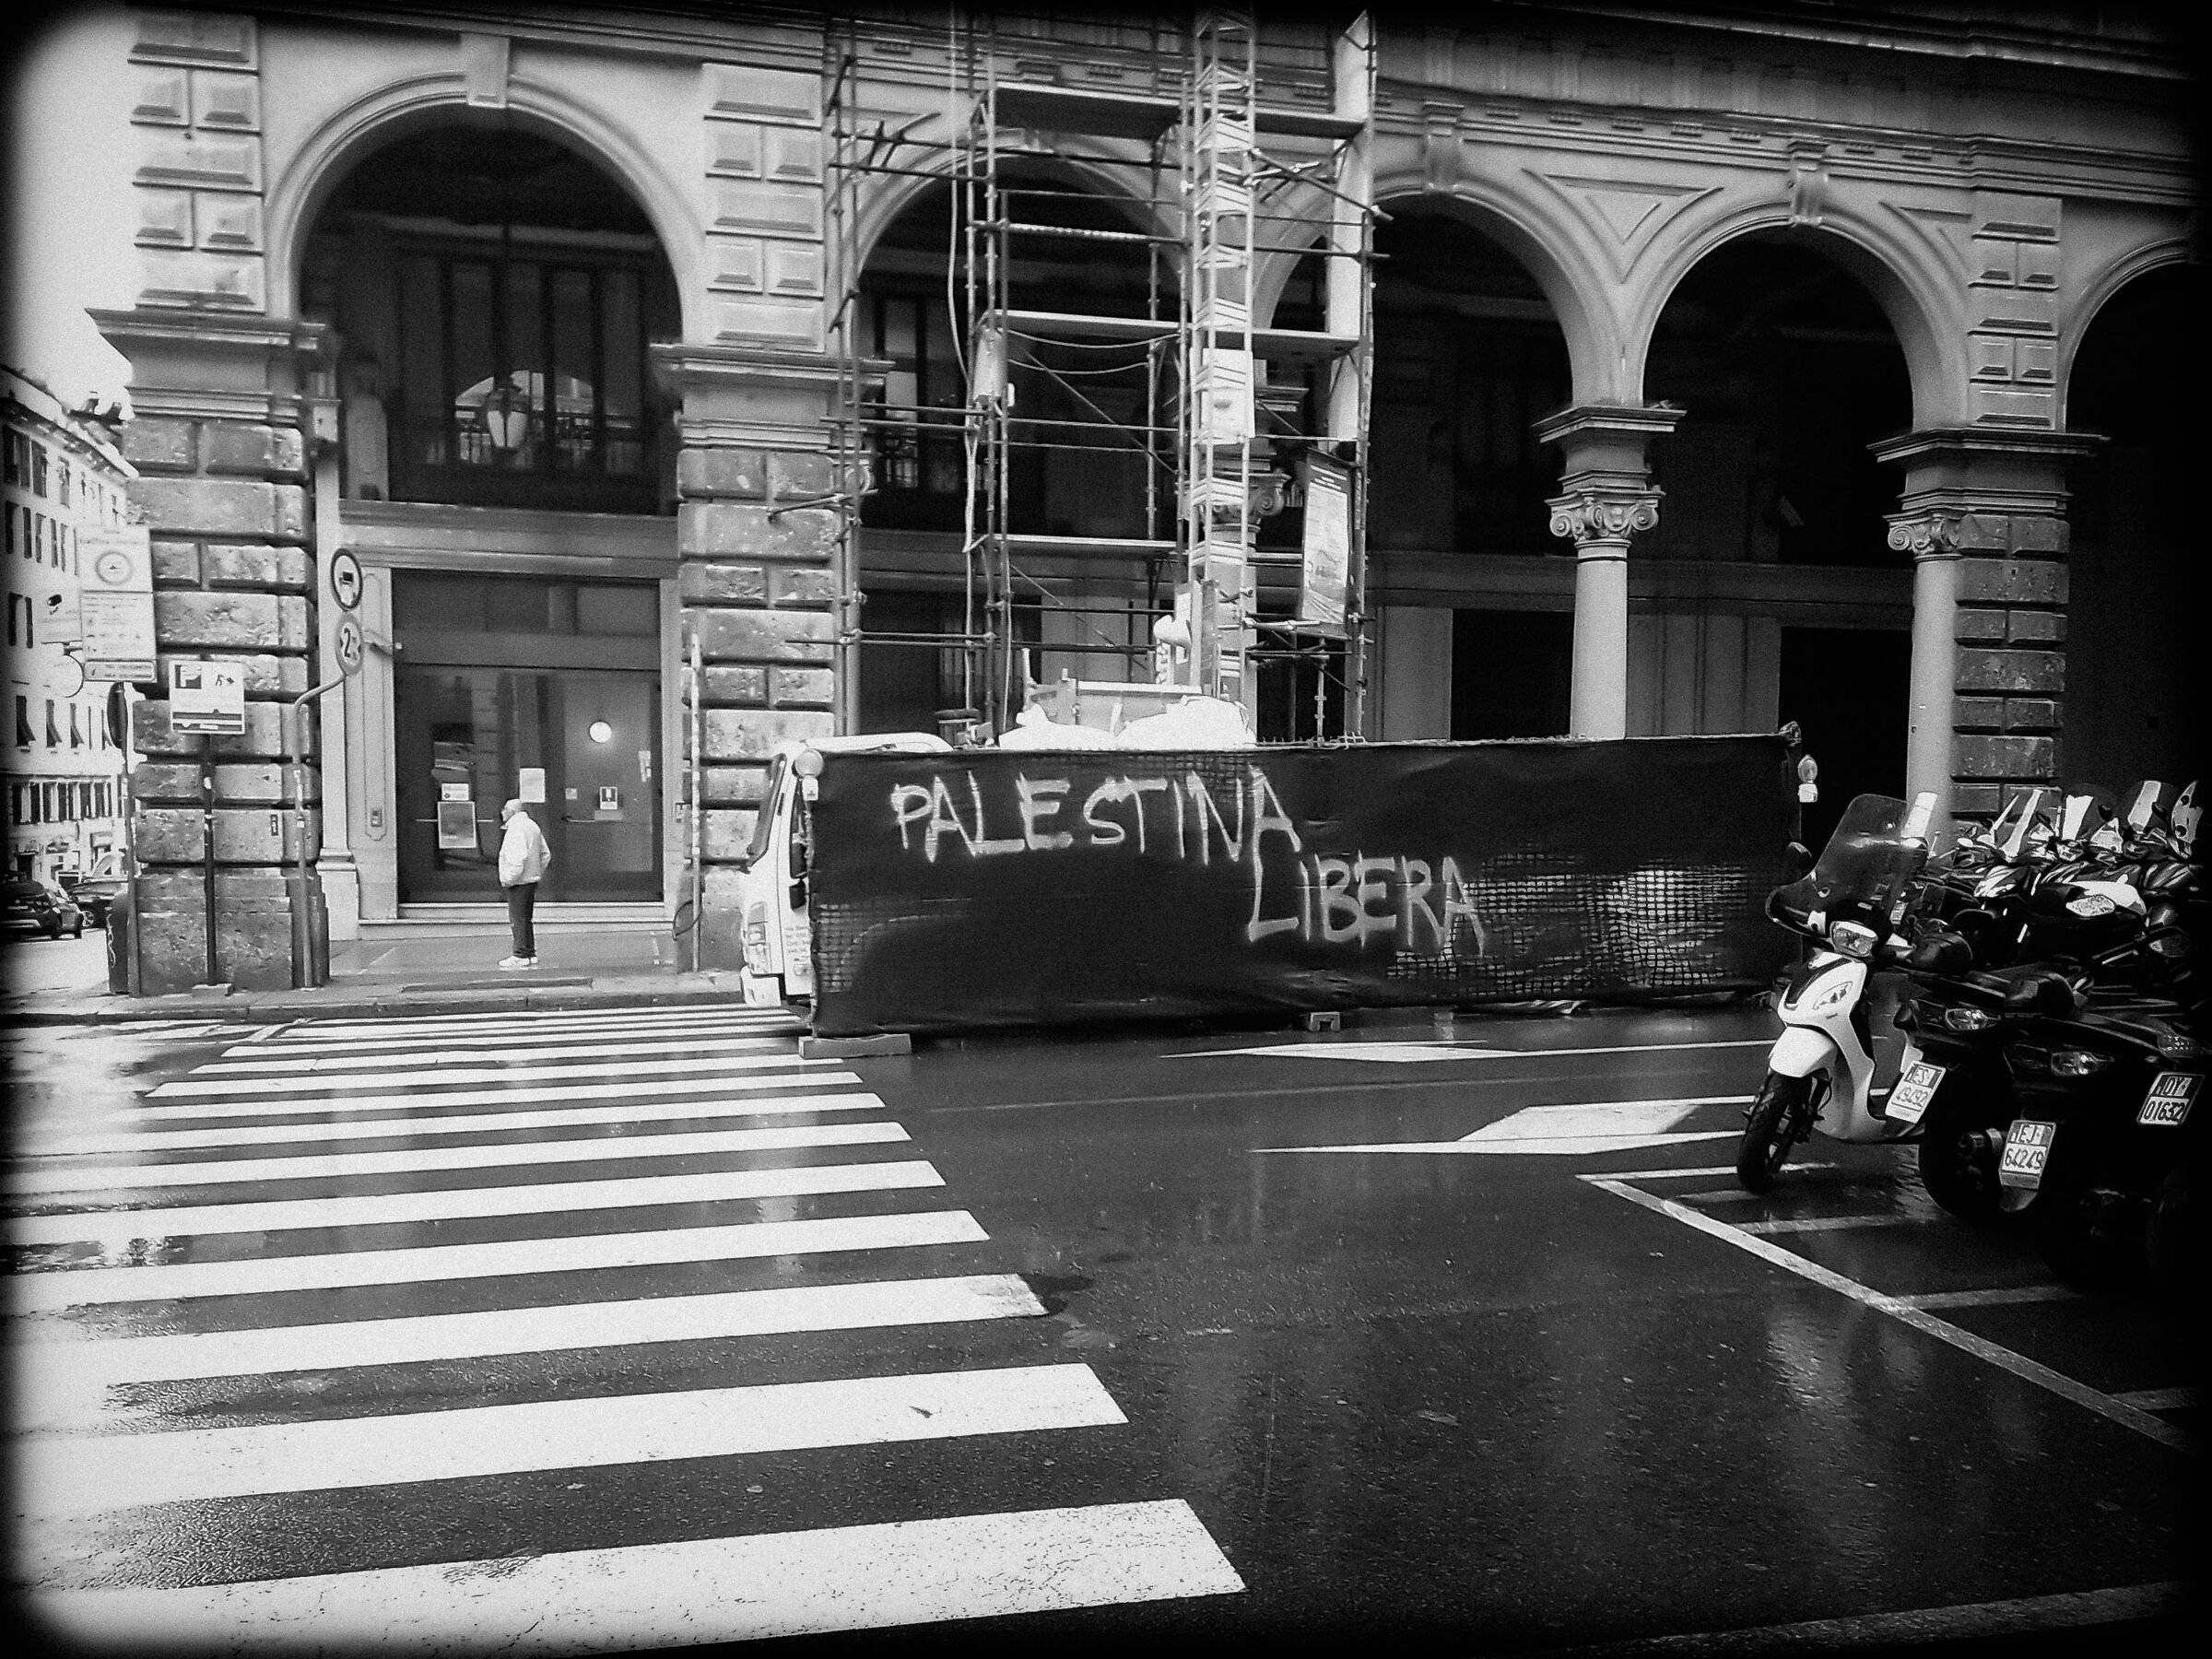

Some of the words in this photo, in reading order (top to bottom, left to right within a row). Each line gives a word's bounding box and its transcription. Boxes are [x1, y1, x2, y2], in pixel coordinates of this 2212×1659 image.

[889, 763, 1302, 865] PALESTINA
[1248, 846, 1486, 956] LIBERA
[2018, 1123, 2038, 1144] EJ
[2143, 1100, 2186, 1122] 01632
